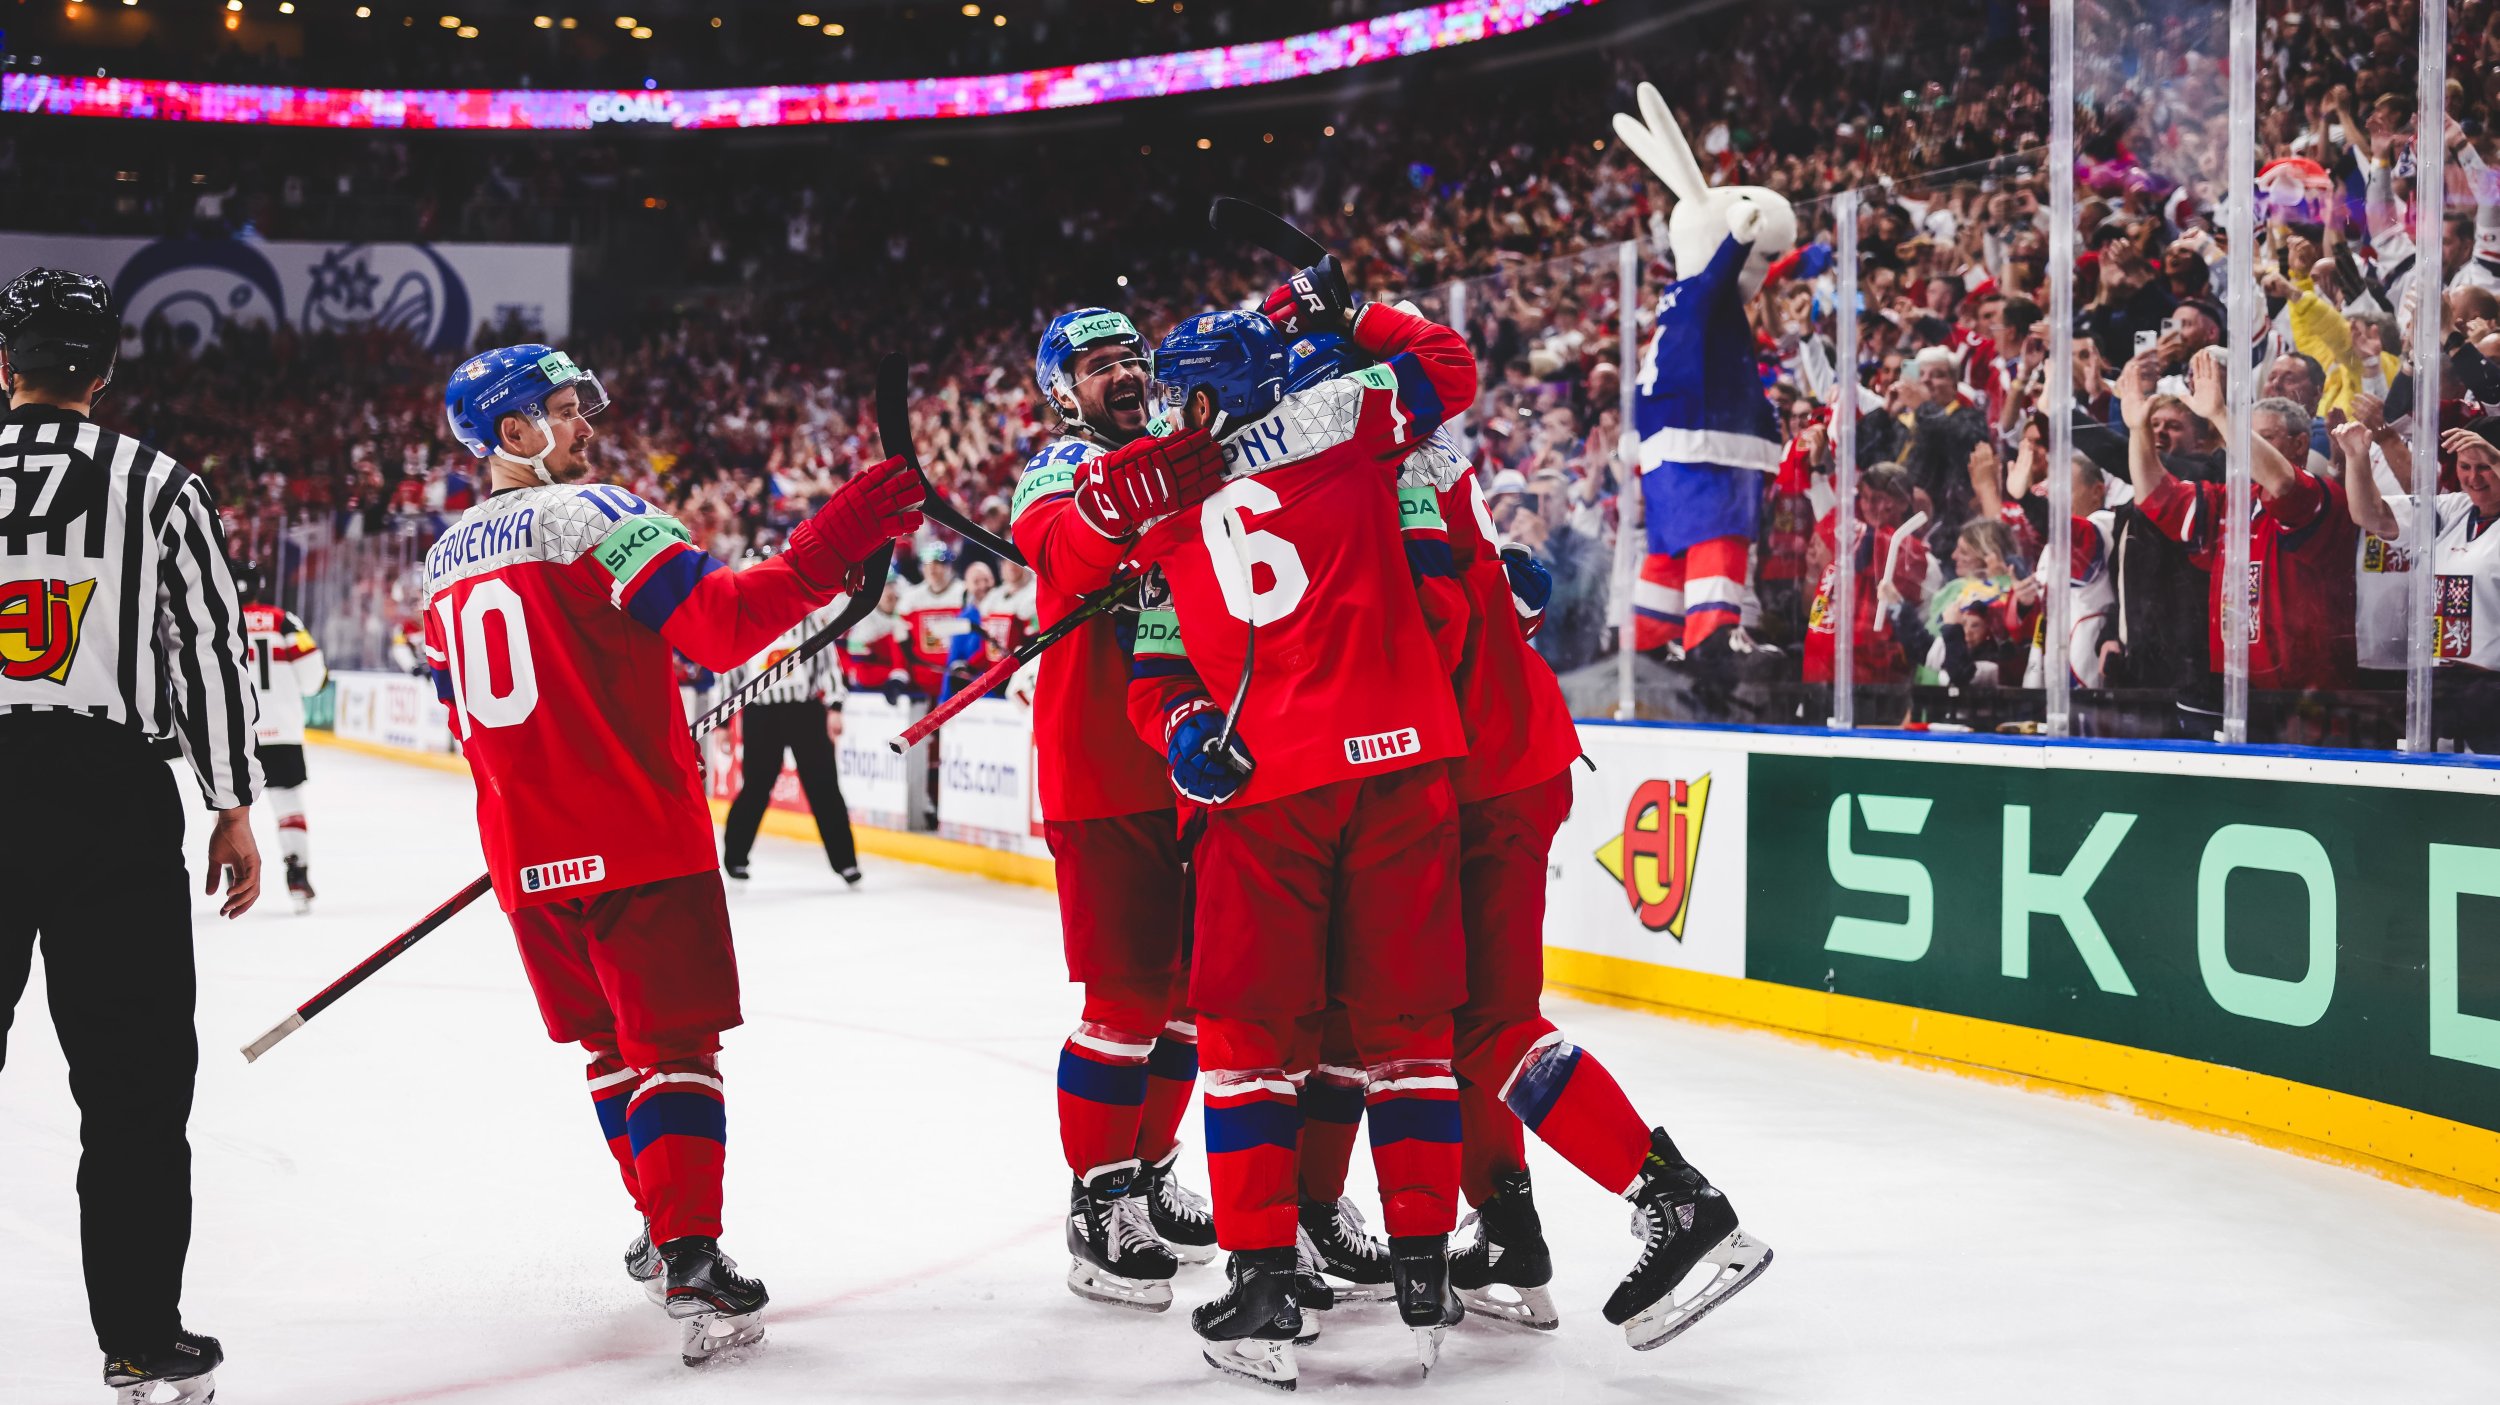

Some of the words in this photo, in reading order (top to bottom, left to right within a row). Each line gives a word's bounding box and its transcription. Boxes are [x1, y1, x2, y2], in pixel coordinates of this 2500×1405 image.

[587, 94, 673, 122] GOAL
[481, 387, 509, 410] CCM
[576, 485, 647, 523] 10
[1200, 477, 1310, 627] 6
[434, 577, 539, 742] 10
[689, 650, 801, 742] RRIOR
[1361, 731, 1412, 759] IIHF
[543, 858, 598, 886] IIHF
